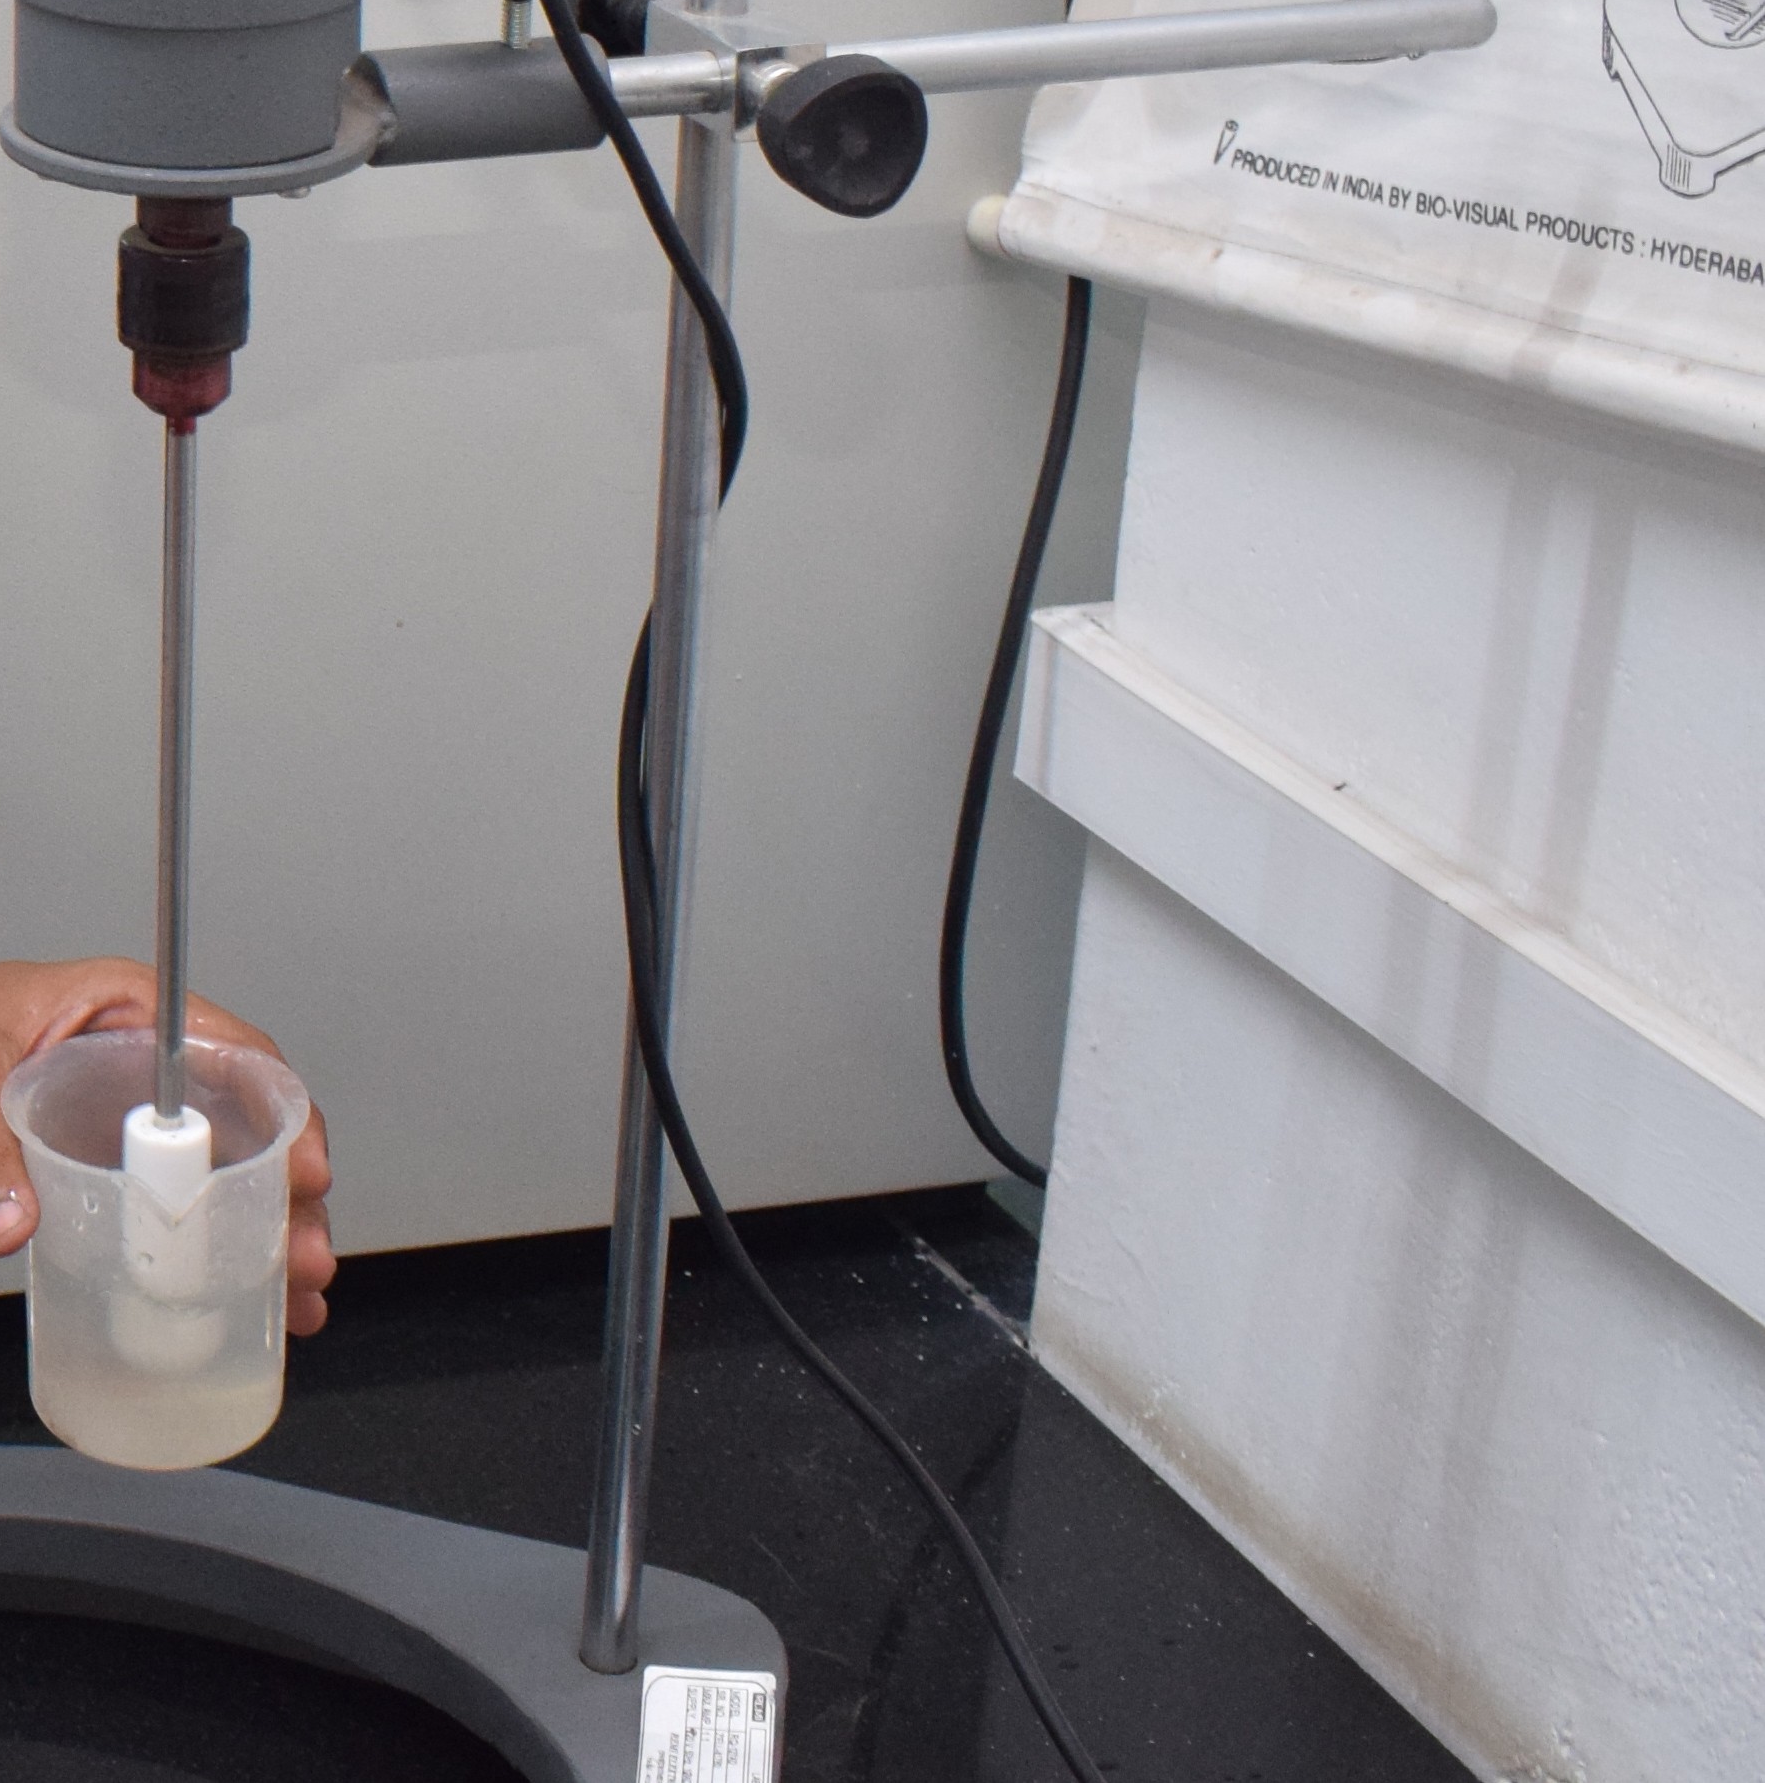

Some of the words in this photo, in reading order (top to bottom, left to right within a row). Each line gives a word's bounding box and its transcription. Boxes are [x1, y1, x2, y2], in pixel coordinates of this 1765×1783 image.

[1231, 148, 1320, 189] PRODUCED
[1322, 169, 1338, 192] IN
[1341, 174, 1384, 205] INDIA
[1388, 186, 1412, 211] BY
[1416, 191, 1519, 233] BIO-VISUAL
[1524, 210, 1635, 256] PRODUCTS
[1651, 238, 1765, 287] HYDERABA
